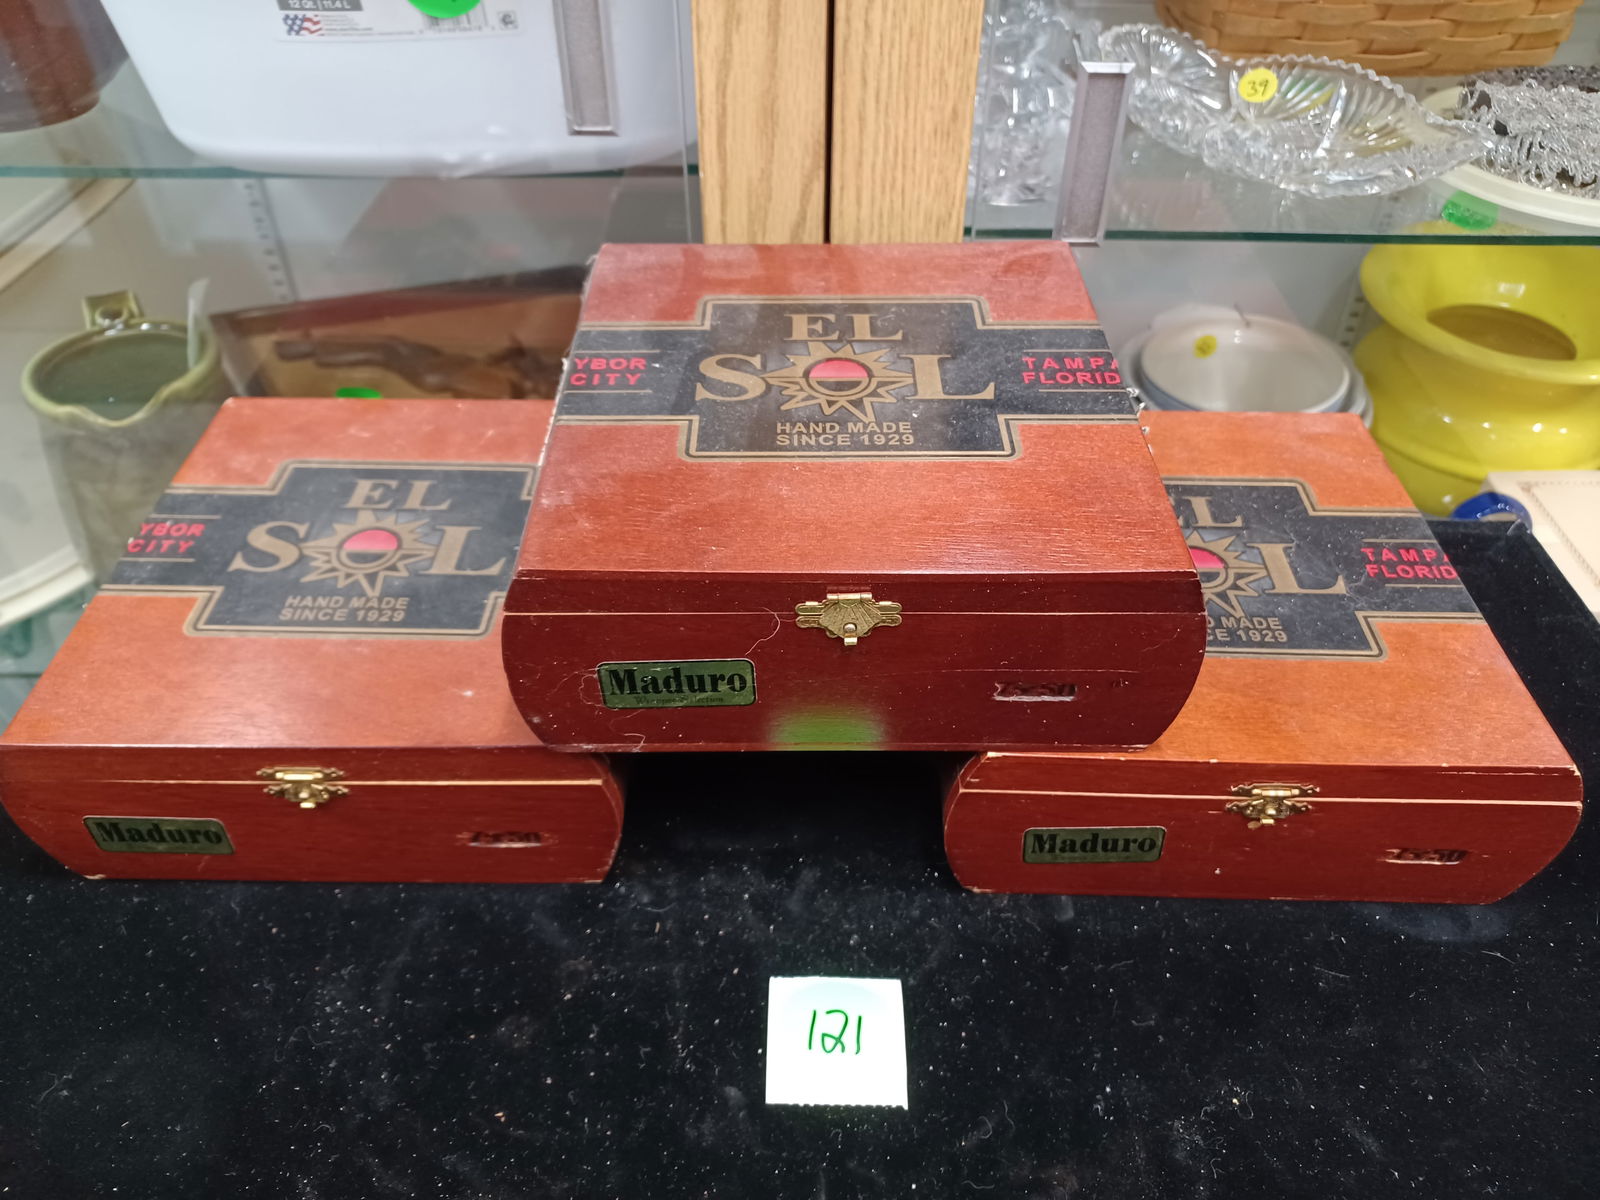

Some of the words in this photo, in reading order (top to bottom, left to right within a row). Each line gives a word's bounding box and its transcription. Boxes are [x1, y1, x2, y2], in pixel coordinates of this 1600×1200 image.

[784, 313, 903, 341] EL
[573, 357, 648, 371] YBOR
[569, 372, 642, 386] CITY
[776, 421, 840, 434] HAND
[848, 421, 913, 434] MADE
[775, 433, 851, 446] SINCE
[860, 433, 915, 446] 1929
[343, 478, 453, 511] EL
[1170, 496, 1243, 528] L
[139, 522, 206, 538] YBOR
[127, 539, 195, 554] CITY
[284, 594, 345, 609] HAND
[349, 596, 411, 610] MADE
[278, 607, 348, 622] SINCE
[355, 609, 406, 622] 1929
[1221, 616, 1283, 630] MADE
[1236, 629, 1289, 643] 1929
[607, 667, 747, 696] Maduro
[94, 821, 223, 845] Maduro
[1030, 832, 1157, 854] Maduro
[808, 1009, 863, 1055] 121
